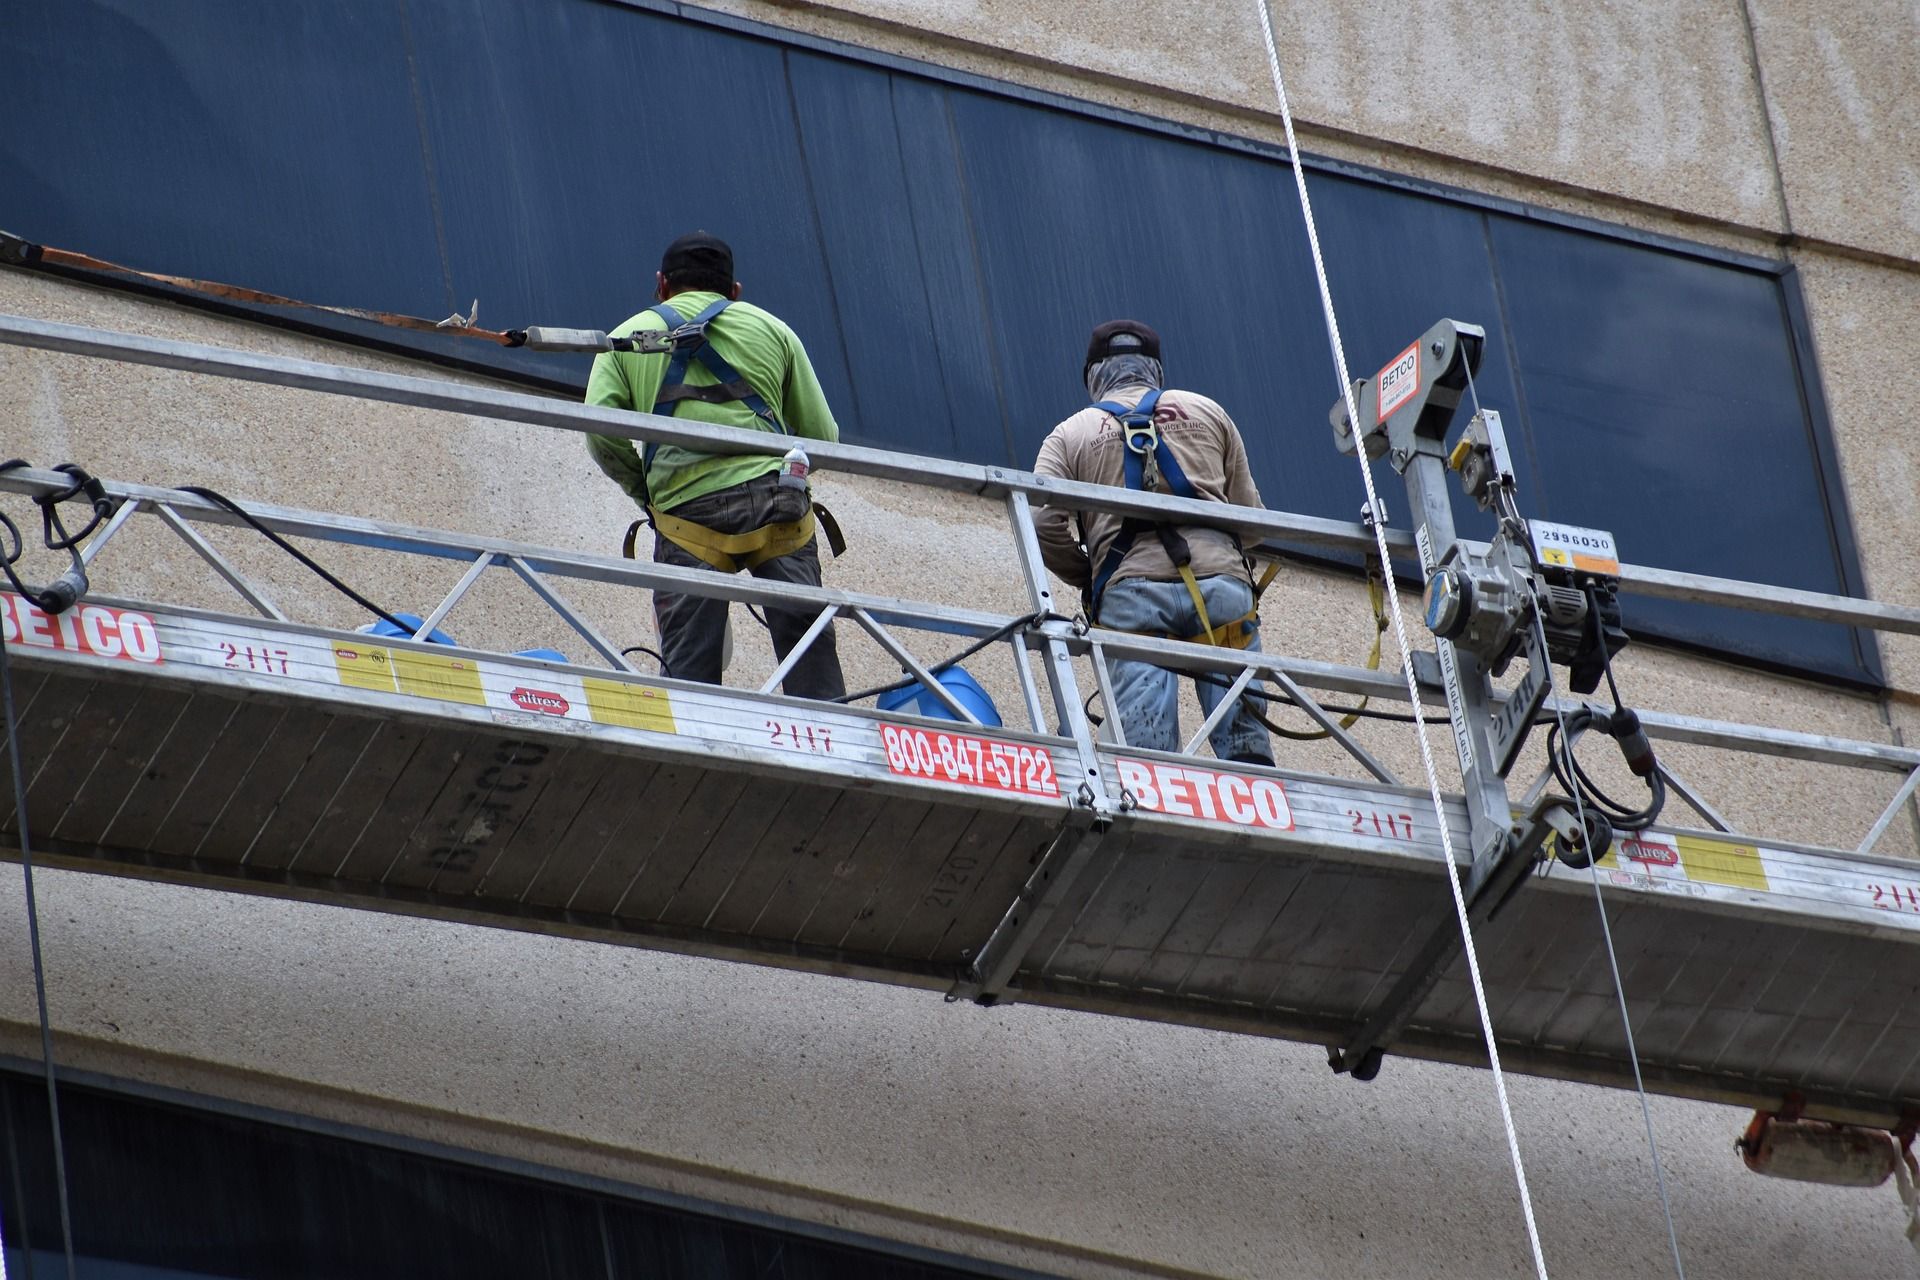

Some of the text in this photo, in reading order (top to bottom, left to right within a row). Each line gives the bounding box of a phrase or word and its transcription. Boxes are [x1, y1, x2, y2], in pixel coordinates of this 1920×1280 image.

[1382, 355, 1415, 391] BETCO
[1542, 530, 1609, 550] 2996030
[219, 641, 288, 675] 2117
[1443, 649, 1454, 674] and
[517, 690, 563, 709] altrex
[1447, 676, 1460, 713] Make
[766, 721, 833, 753] 2117
[883, 727, 1057, 793] 800-847-5722
[1117, 760, 1292, 831] BETCO
[1347, 810, 1412, 840] 2117
[1867, 884, 1920, 912] 211
